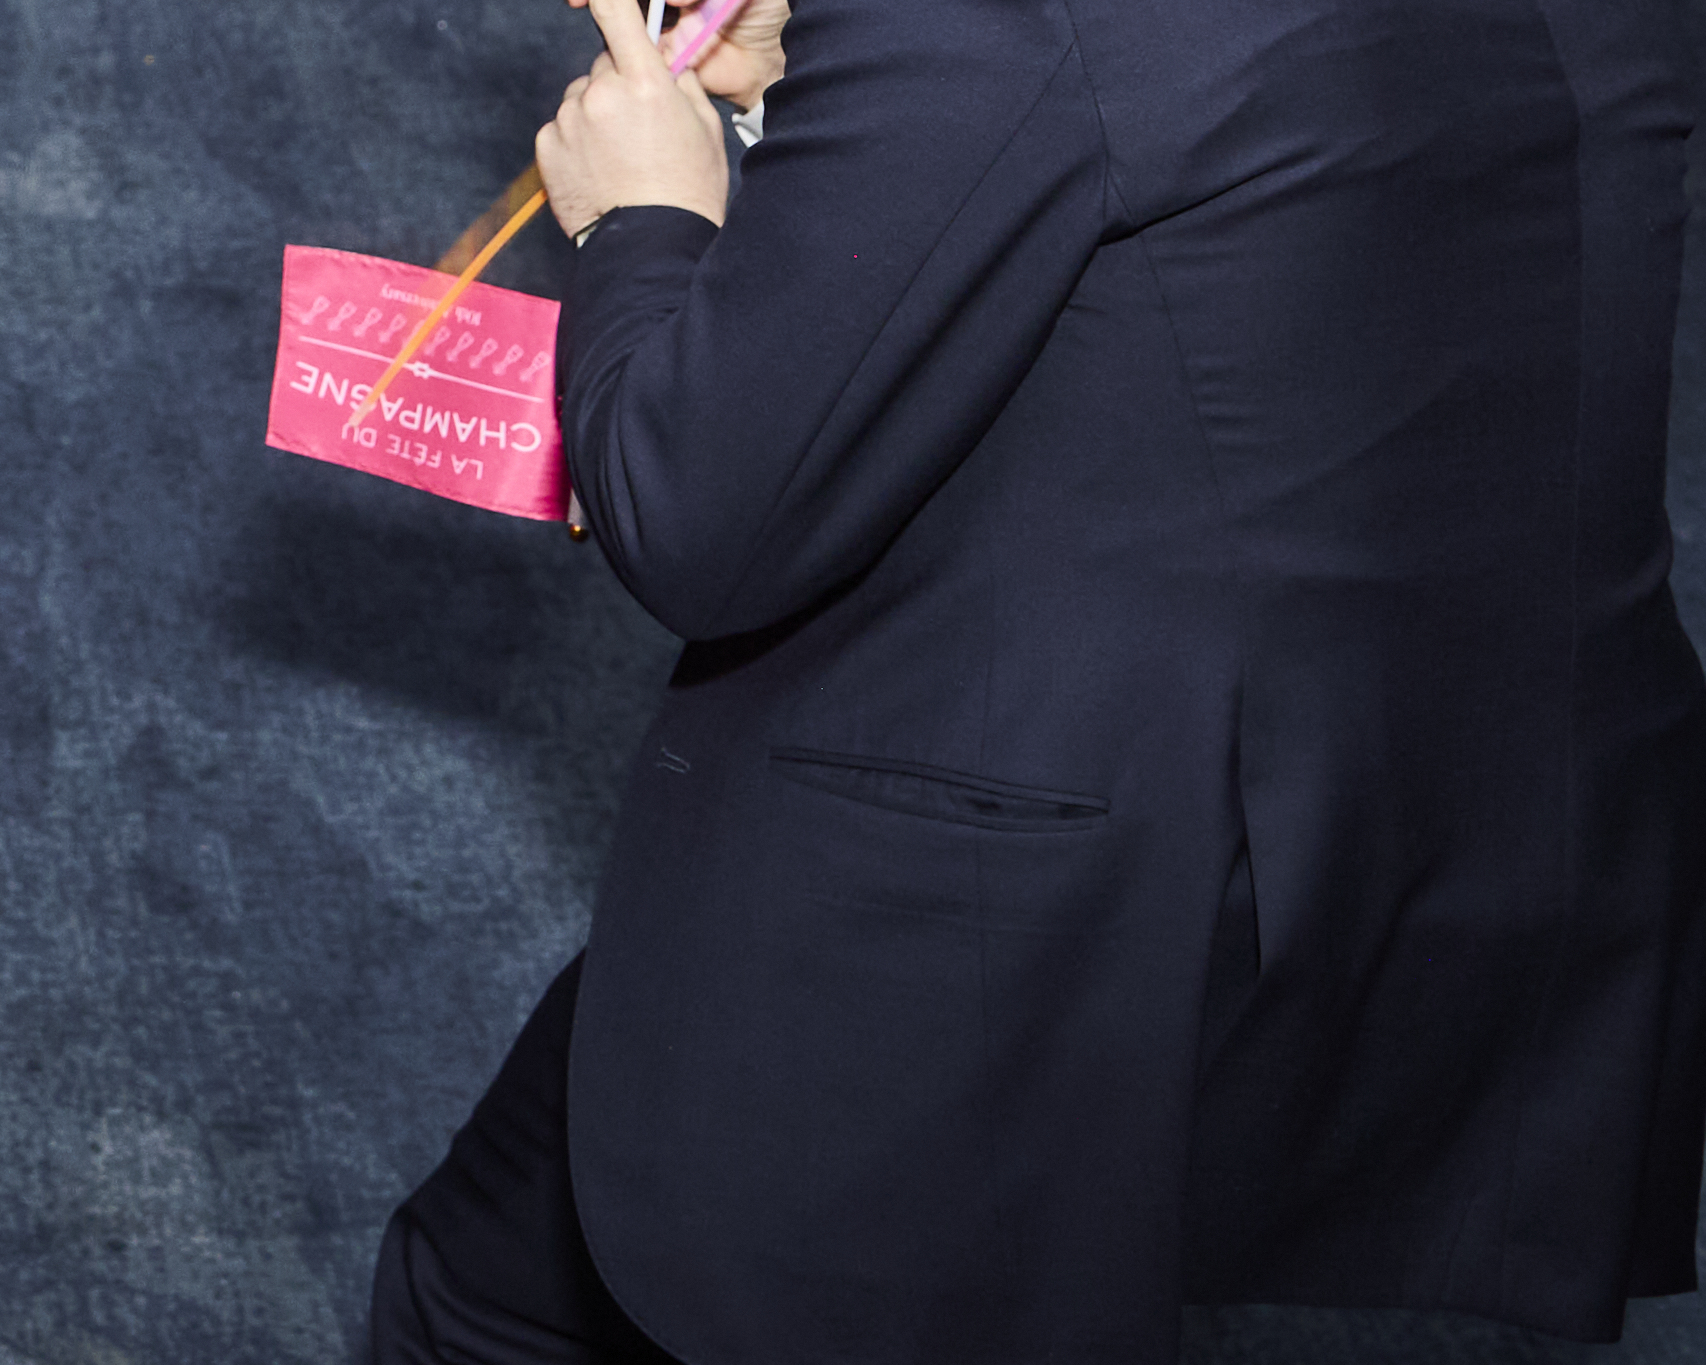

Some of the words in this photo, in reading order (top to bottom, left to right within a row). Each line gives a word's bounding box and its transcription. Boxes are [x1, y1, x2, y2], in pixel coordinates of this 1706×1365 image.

[289, 360, 542, 452] CHAMPAGNE
[341, 423, 378, 448] DU
[385, 434, 442, 468] FÊTE
[451, 454, 484, 480] LA
